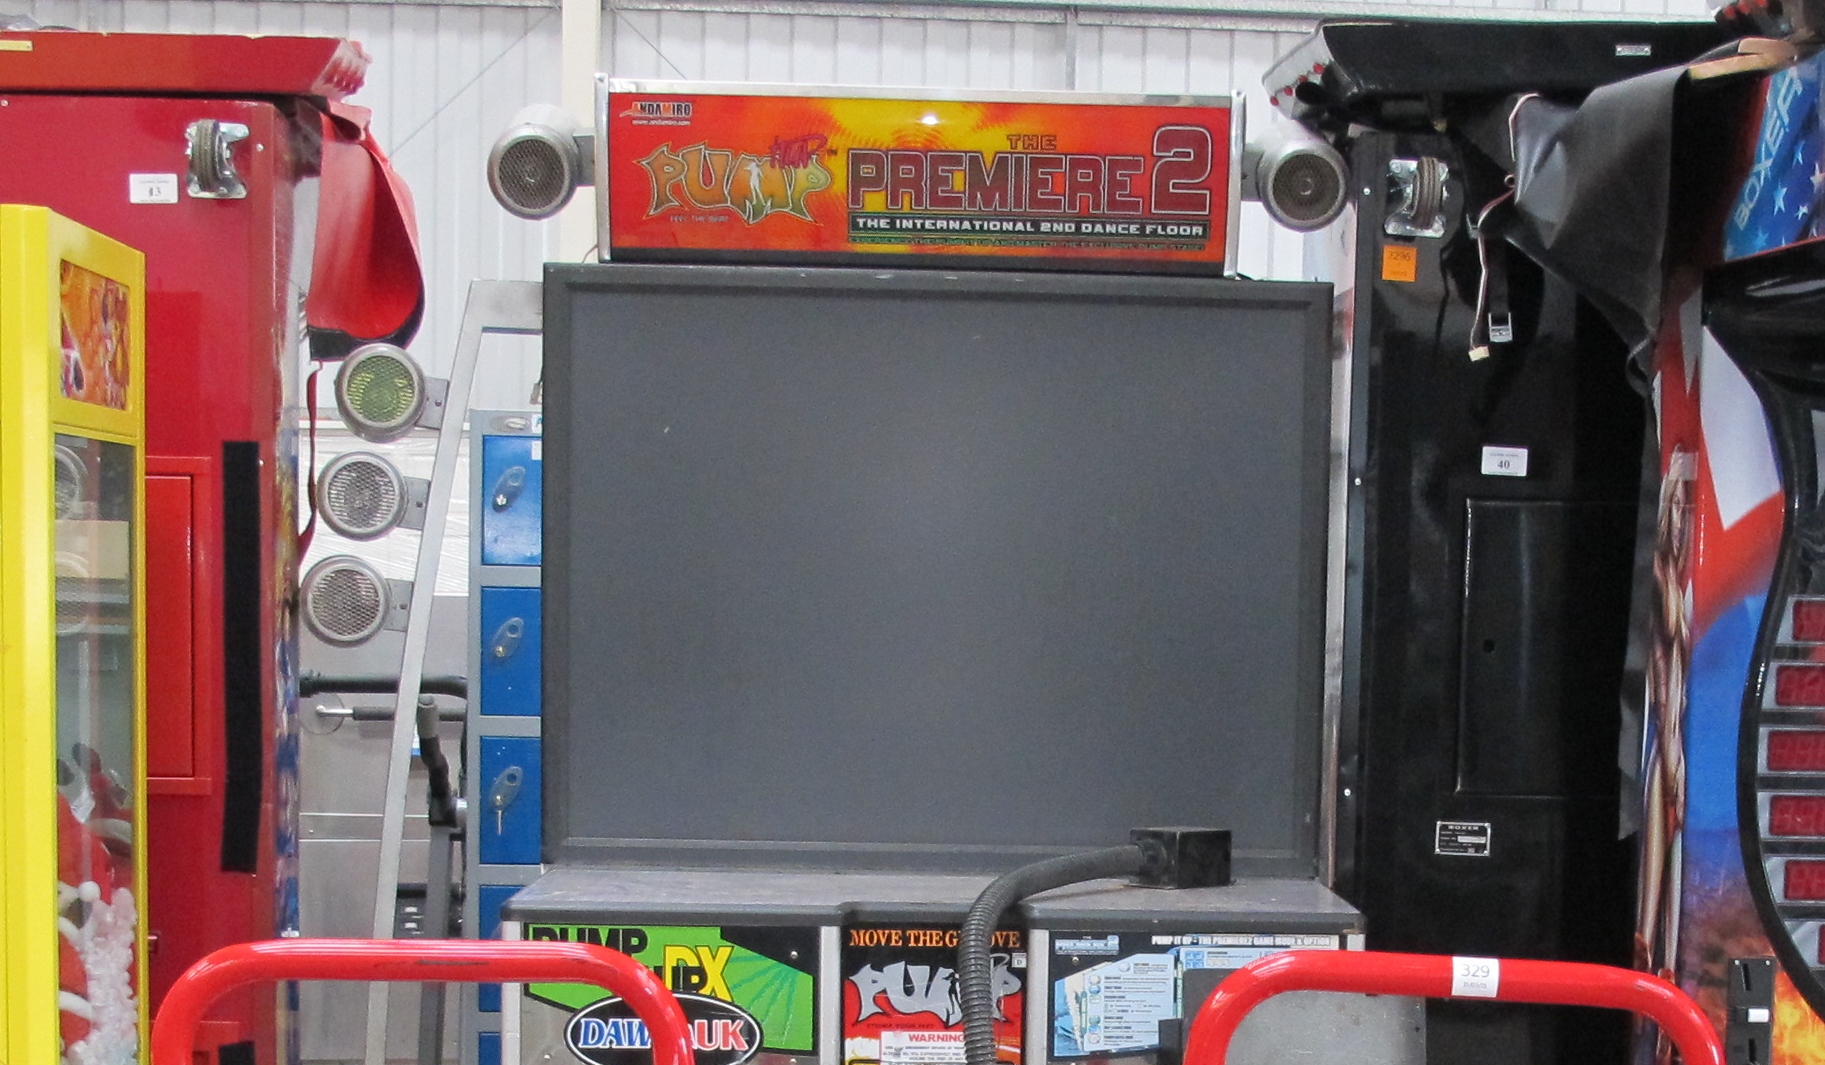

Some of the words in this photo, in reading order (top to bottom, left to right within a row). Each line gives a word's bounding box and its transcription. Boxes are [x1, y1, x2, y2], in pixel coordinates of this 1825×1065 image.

[630, 101, 693, 118] ANDAMIRO
[1007, 134, 1057, 150] THE
[847, 149, 1145, 215] PREMIERE
[1150, 123, 1214, 216] 2
[634, 142, 832, 225] PUMP
[856, 217, 891, 229] THE
[895, 218, 1035, 232] INTERNATIONAL
[1040, 221, 1075, 233] 2ND
[1081, 223, 1140, 234] DANCE
[1145, 224, 1203, 236] FLOOR
[1496, 459, 1510, 469] 40
[849, 928, 903, 947] MOVE
[906, 929, 944, 948] THE
[944, 929, 1021, 948] GVE
[664, 944, 735, 1003] DX
[1460, 963, 1491, 978] 329
[694, 1019, 749, 1051] UK
[908, 1033, 965, 1043] WARNING
